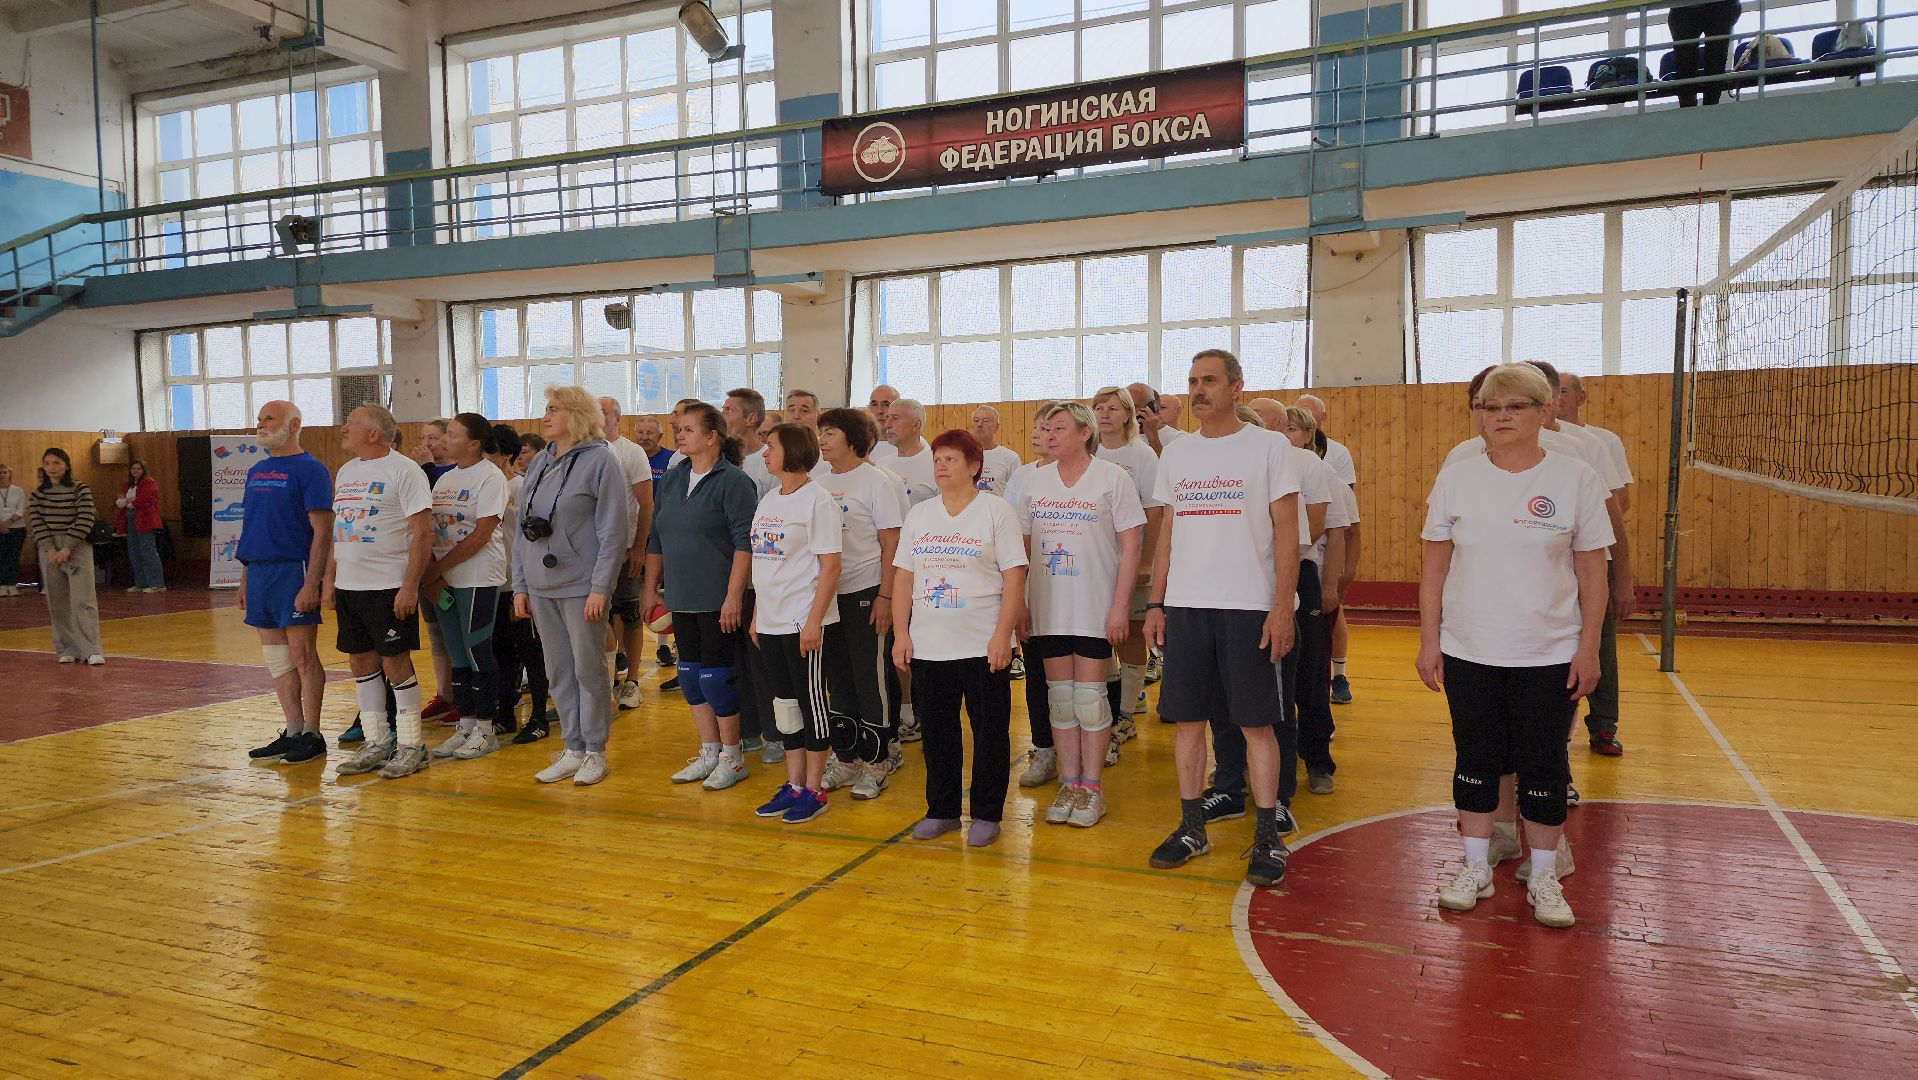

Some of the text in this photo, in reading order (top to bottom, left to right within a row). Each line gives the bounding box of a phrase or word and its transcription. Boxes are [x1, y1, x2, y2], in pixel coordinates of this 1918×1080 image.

[986, 87, 1157, 134] НОГИНСКАЯ
[939, 114, 1211, 171] ФЕДЕРАЦИЯ БОКСА
[1175, 476, 1243, 492] Активное
[1030, 496, 1097, 511] Активное
[912, 531, 983, 547] Активное
[1457, 773, 1483, 785] ALLSIX
